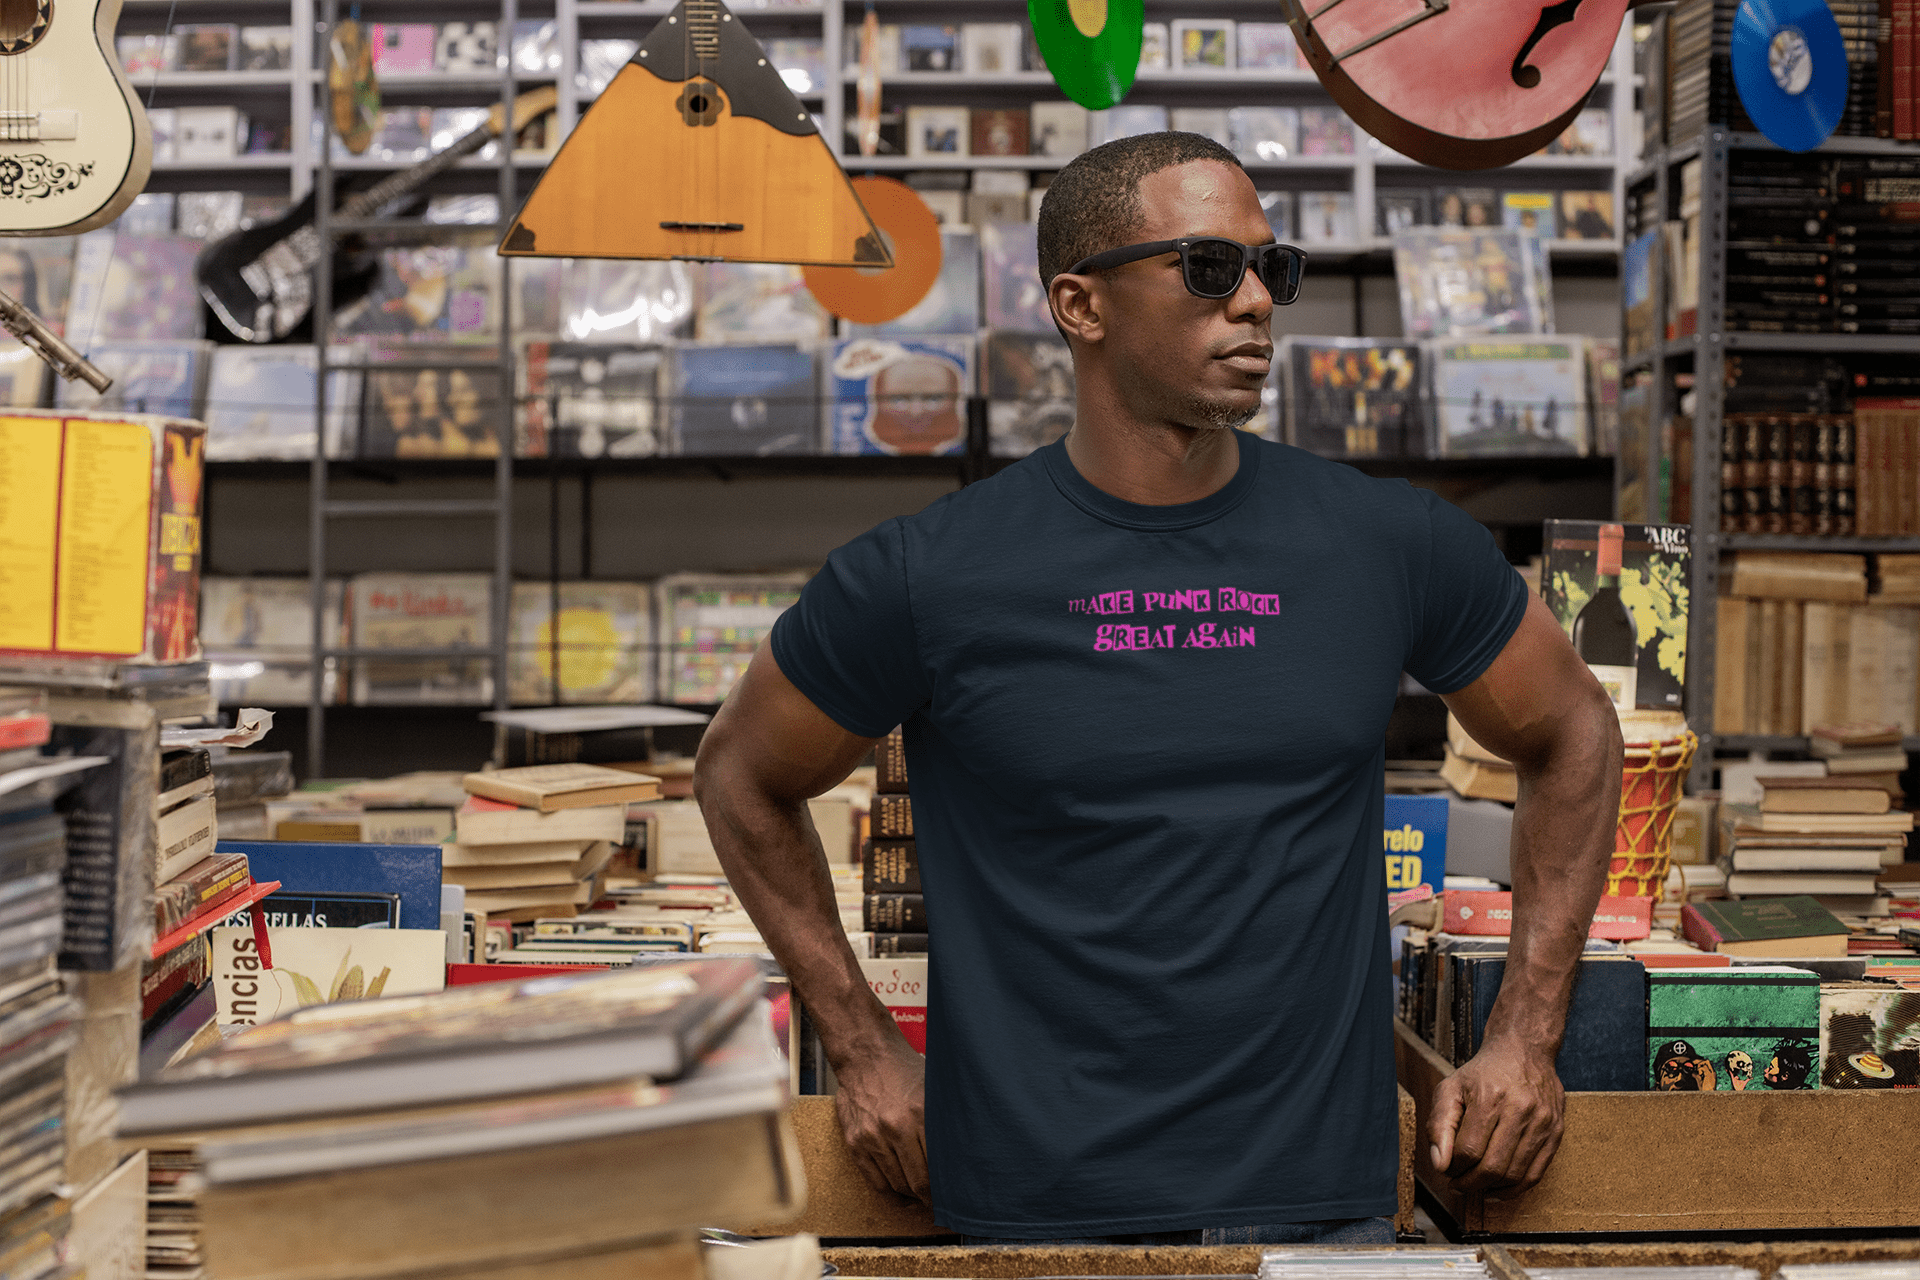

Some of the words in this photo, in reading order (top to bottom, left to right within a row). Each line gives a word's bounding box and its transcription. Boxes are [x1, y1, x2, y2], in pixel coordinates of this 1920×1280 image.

[1218, 587, 1280, 615] ROCK
[881, 797, 889, 835] AMADO
[873, 847, 881, 884] AMADO
